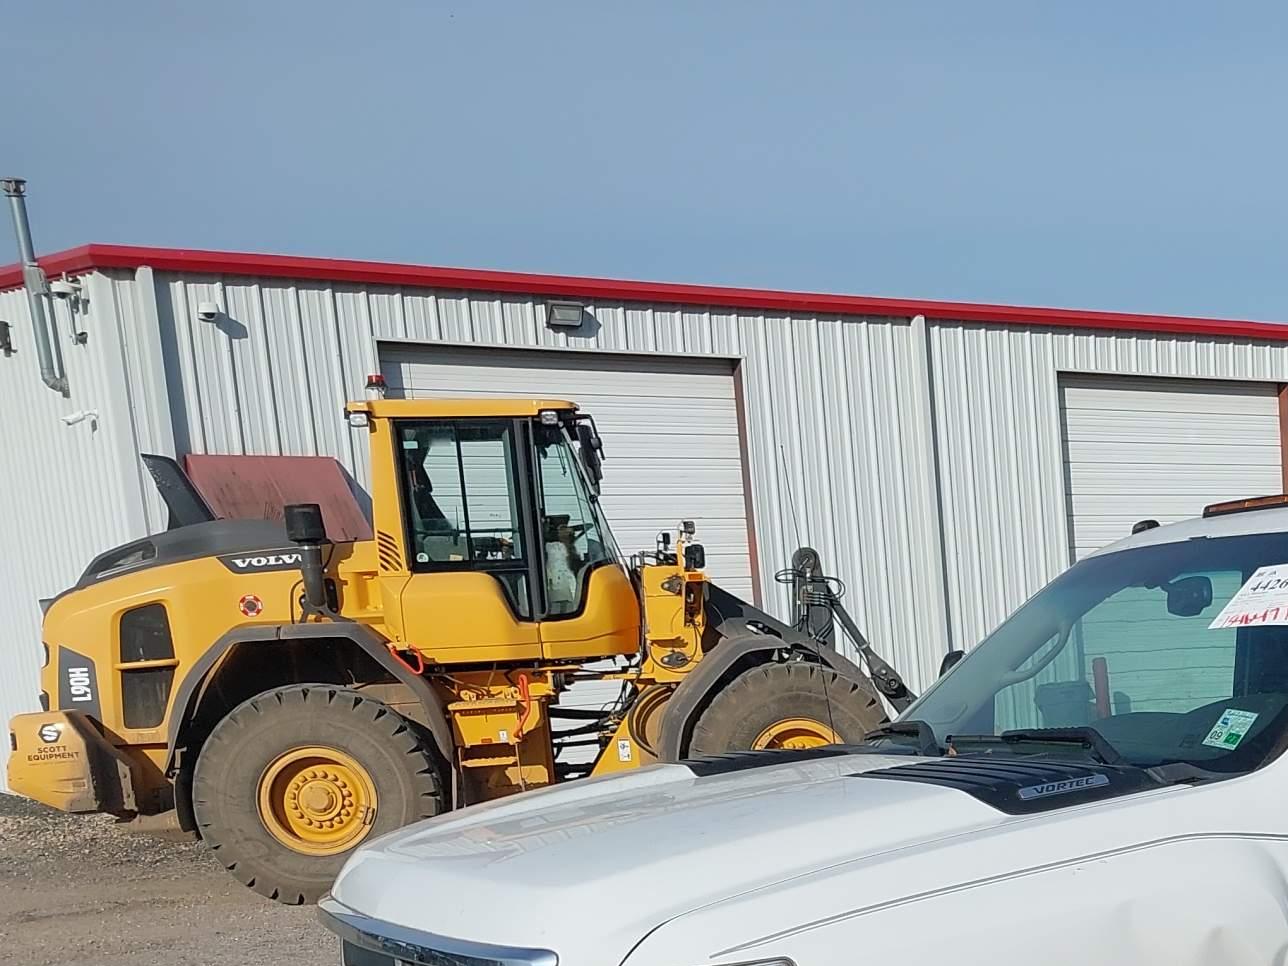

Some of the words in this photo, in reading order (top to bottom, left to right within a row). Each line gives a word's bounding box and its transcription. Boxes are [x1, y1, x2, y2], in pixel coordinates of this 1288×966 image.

[231, 554, 302, 568] VOLV
[68, 667, 92, 702] L90H
[27, 751, 80, 762] EQUIPMENT
[37, 745, 67, 754] SCOTT
[1033, 776, 1096, 794] VORTEC
